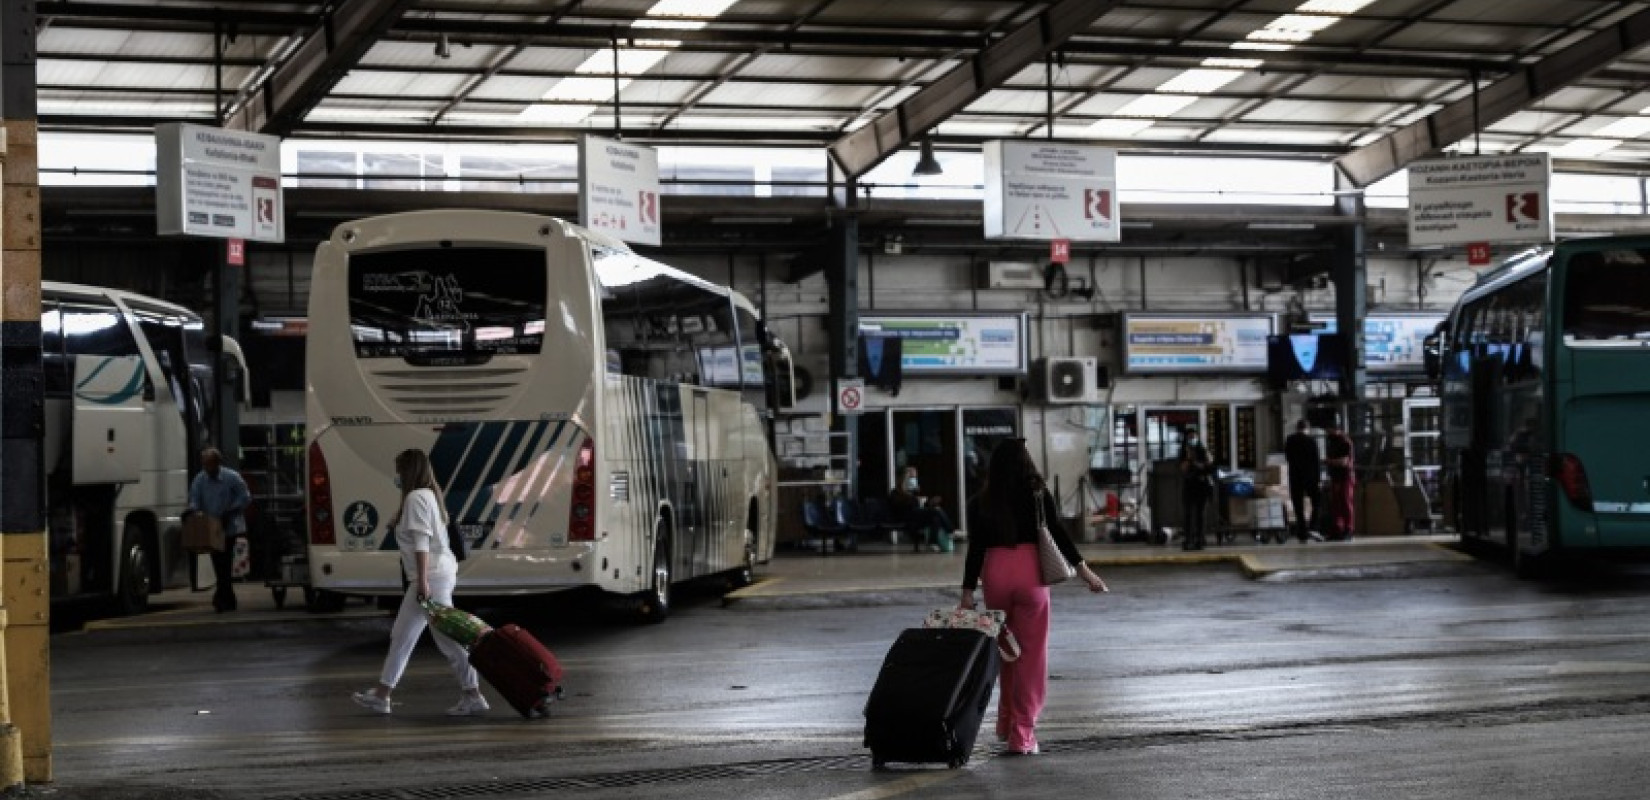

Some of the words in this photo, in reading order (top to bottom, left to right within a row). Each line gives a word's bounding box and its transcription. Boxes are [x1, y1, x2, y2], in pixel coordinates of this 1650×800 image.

[1055, 244, 1068, 256] 14
[1471, 246, 1487, 260] 15
[331, 416, 373, 425] VOLVO
